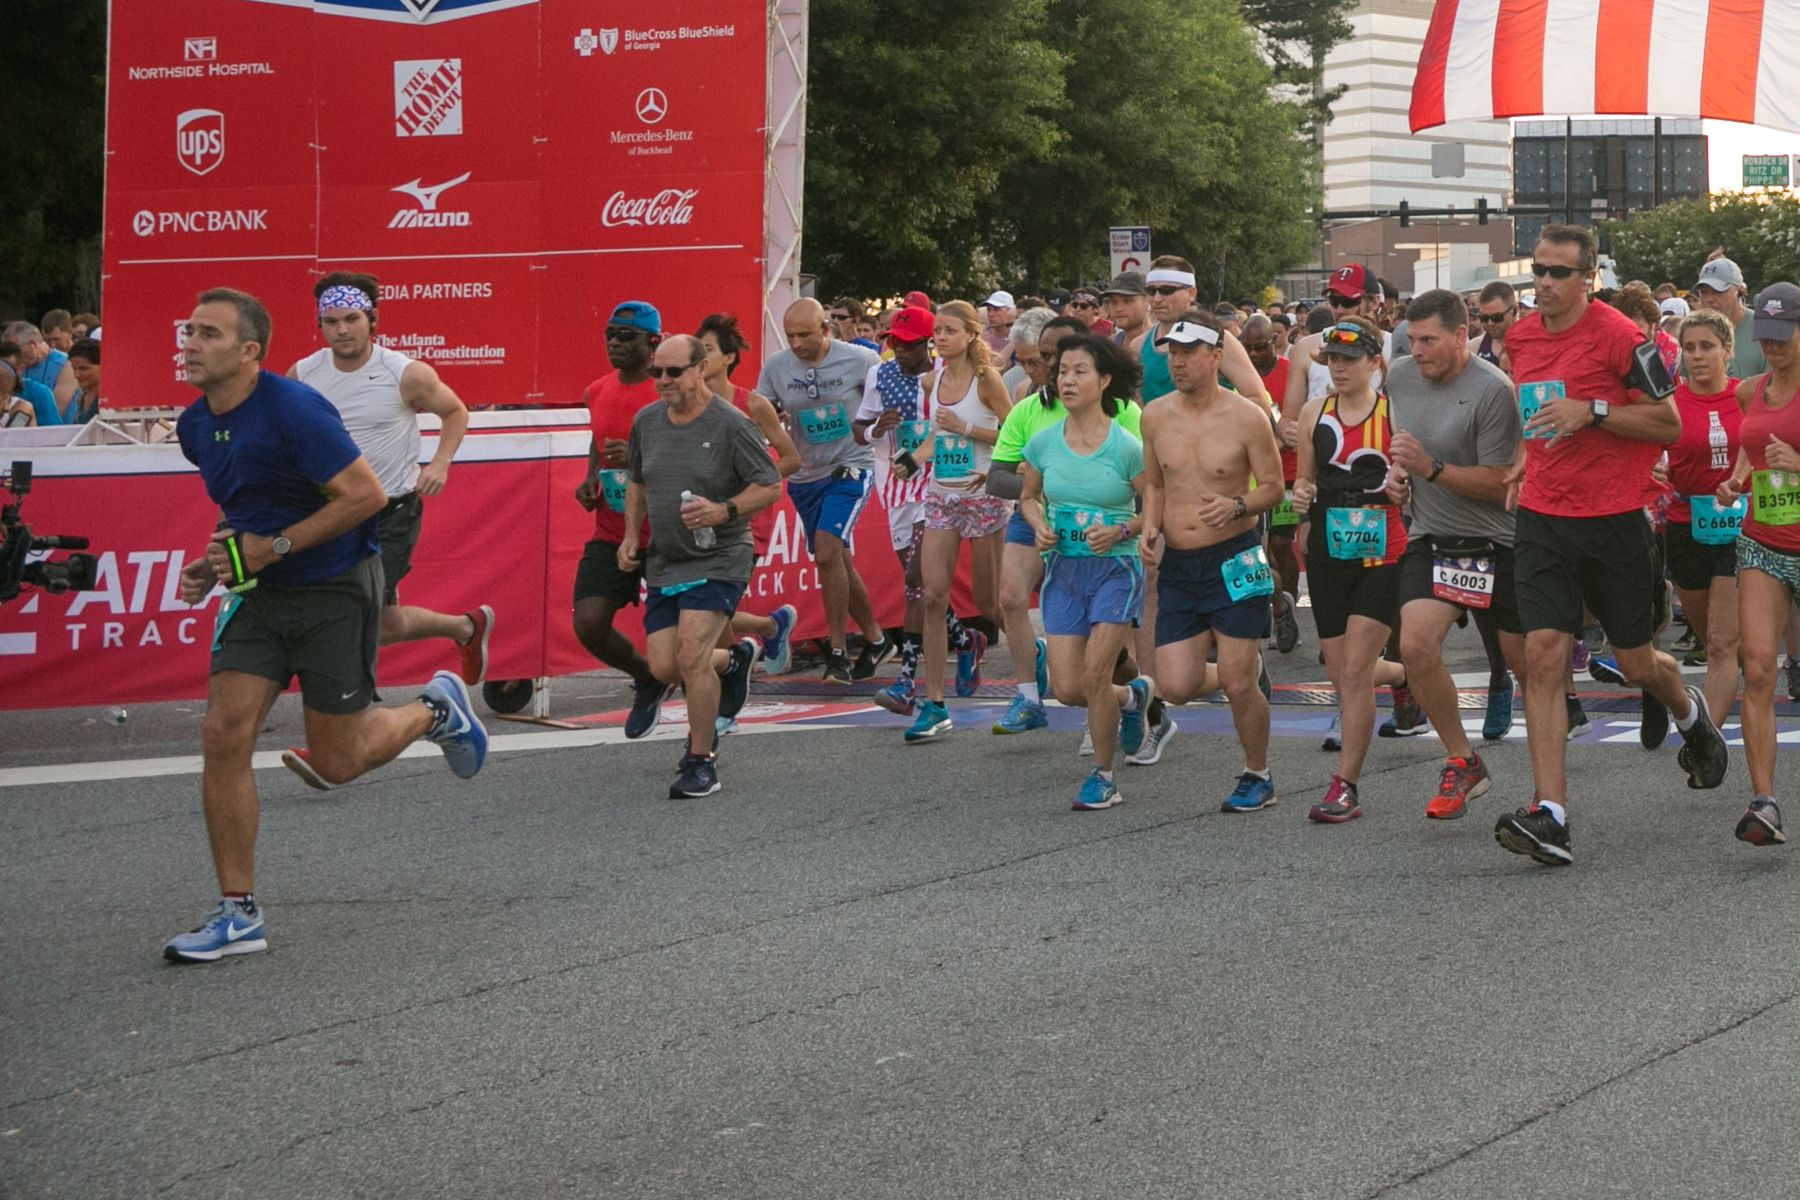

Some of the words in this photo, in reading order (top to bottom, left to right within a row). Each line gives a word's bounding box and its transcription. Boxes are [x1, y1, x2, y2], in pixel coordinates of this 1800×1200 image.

[625, 28, 676, 41] BlueCross
[679, 25, 735, 39] BlueShield
[625, 42, 632, 50] of
[634, 42, 660, 51] Georgia
[401, 68, 430, 98] THE
[396, 58, 462, 136] HOME
[422, 86, 462, 135] DEPOT
[610, 129, 693, 144] Mercedes-Benz
[628, 147, 637, 156] of
[637, 145, 672, 155] Buckhead
[1750, 167, 1767, 176] RITZ
[1771, 167, 1782, 176] DR
[1744, 176, 1774, 185] PHIPPS
[602, 189, 699, 227] Coca-Cola
[158, 211, 205, 233] PNC
[207, 209, 268, 231] BANK
[378, 284, 409, 300] EDIA
[413, 282, 492, 299] PARTNERS
[375, 334, 398, 347] The
[399, 333, 445, 346] Atlanta
[403, 345, 505, 359] nal-Constitution
[787, 379, 843, 392] PAHERS
[807, 424, 815, 433] C
[817, 418, 844, 432] 8202
[902, 439, 909, 448] C
[936, 455, 942, 464] C
[942, 454, 969, 465] 7126
[606, 488, 613, 498] C
[1758, 495, 1767, 508] B
[1698, 517, 1706, 529] C
[1710, 516, 1743, 529] 6682
[1059, 528, 1067, 540] C
[1333, 531, 1342, 542] C
[1344, 531, 1380, 544] 7704
[799, 567, 823, 591] CL
[1233, 577, 1243, 588] C
[1246, 568, 1271, 583] 8493
[1440, 571, 1448, 582] C
[1451, 573, 1487, 590] 6003
[65, 617, 198, 650] TRAC
